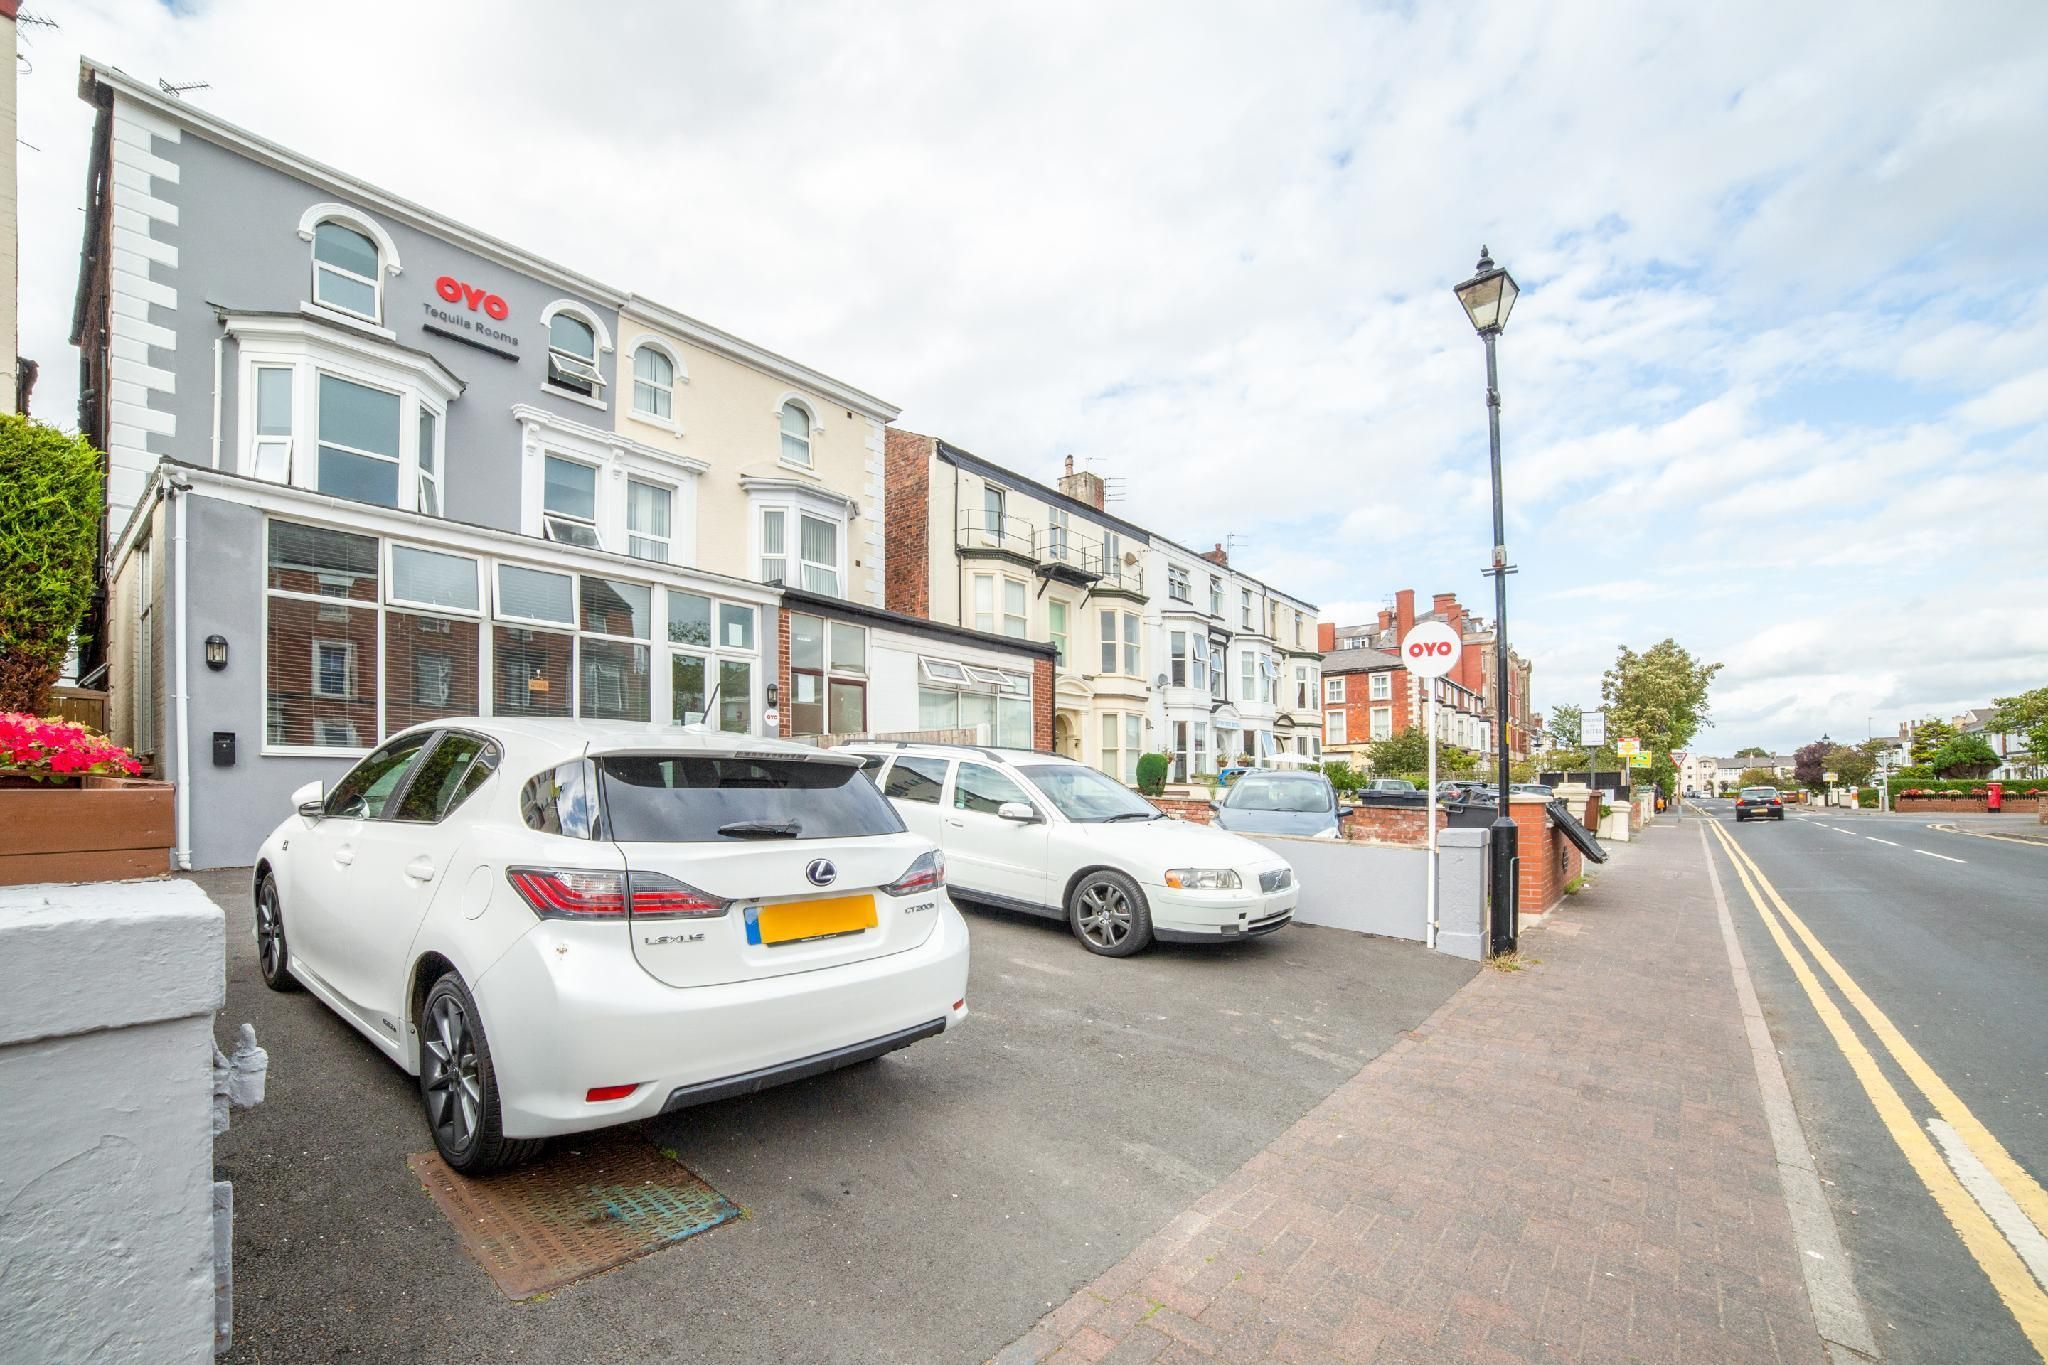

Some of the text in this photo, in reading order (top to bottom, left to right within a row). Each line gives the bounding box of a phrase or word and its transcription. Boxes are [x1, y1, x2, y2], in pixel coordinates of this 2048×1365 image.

[435, 276, 509, 320] OYO
[423, 303, 519, 346] Tequila Rooms
[1409, 641, 1452, 658] OYO
